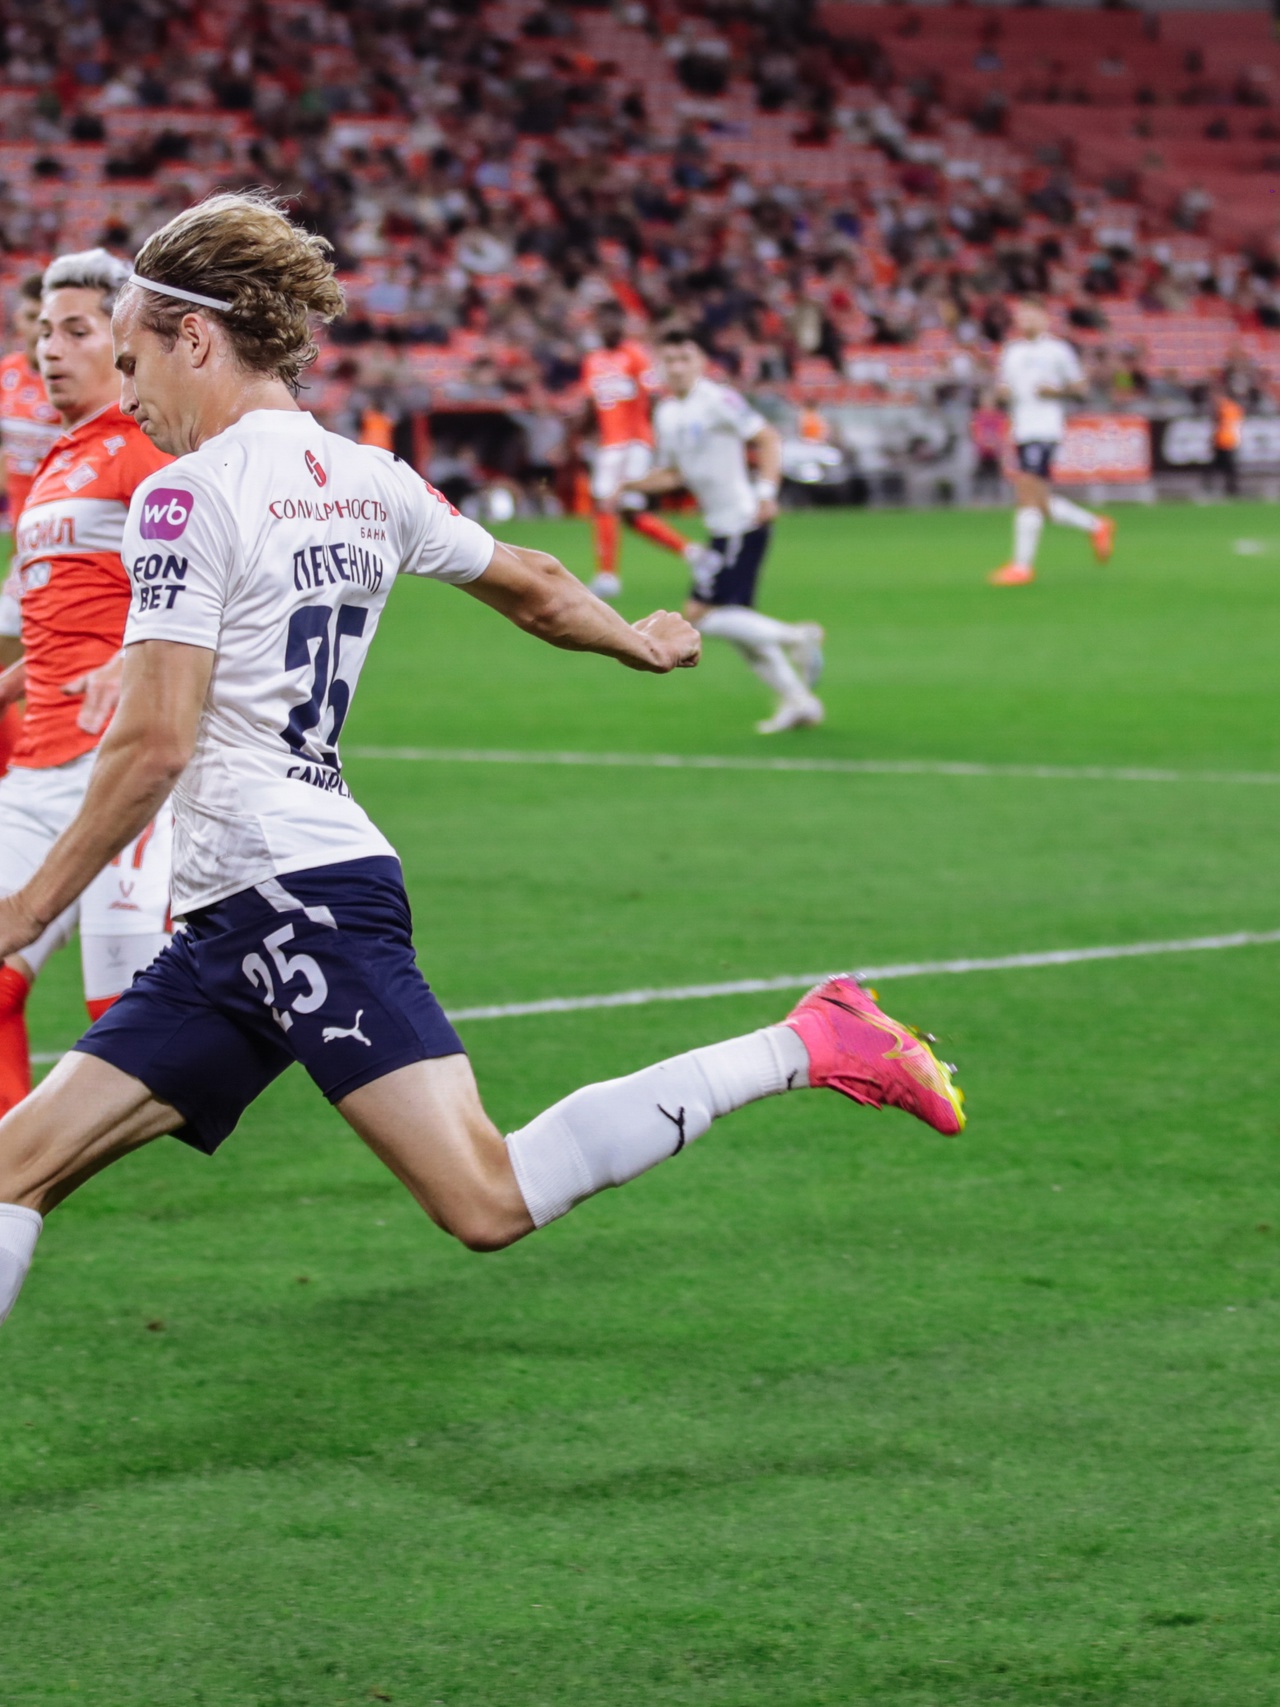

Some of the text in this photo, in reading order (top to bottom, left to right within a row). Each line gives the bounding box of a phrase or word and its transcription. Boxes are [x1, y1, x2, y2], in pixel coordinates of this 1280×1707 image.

[144, 498, 188, 526] wb
[268, 498, 387, 522] СОЛИДРНОСТЬ
[360, 526, 387, 541] БАНК
[133, 553, 189, 583] FON
[138, 584, 187, 613] BET
[280, 604, 370, 773] 25
[241, 922, 329, 1034] 25
